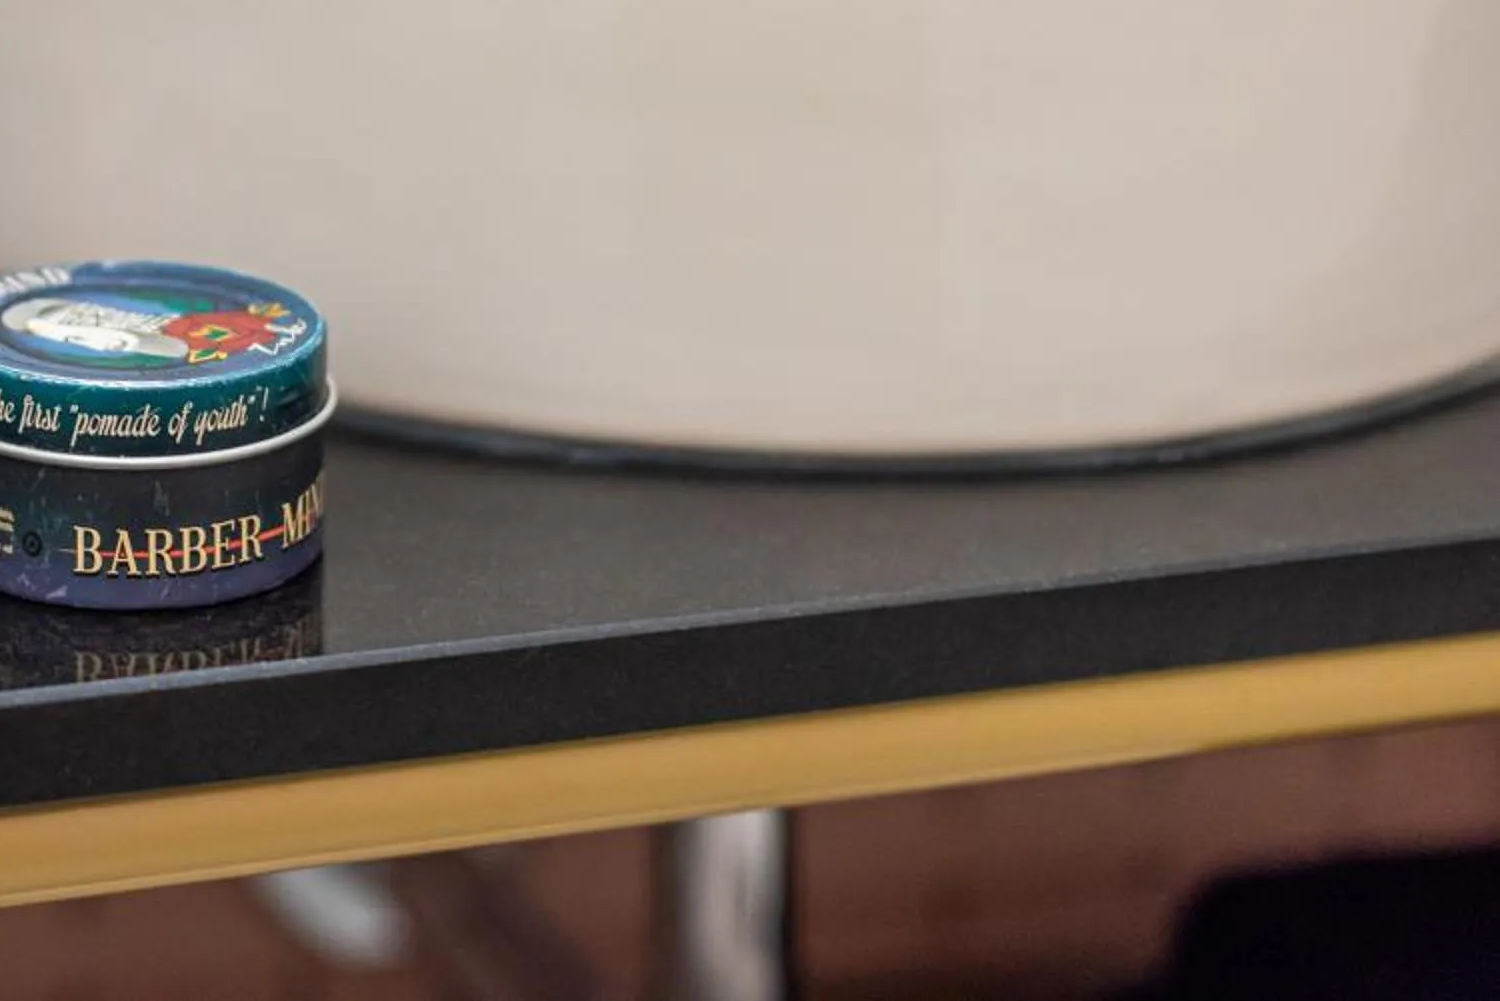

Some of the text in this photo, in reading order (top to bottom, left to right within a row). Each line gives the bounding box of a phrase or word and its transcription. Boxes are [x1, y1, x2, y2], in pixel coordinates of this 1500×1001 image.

[17, 394, 62, 434] first
[168, 400, 194, 444] of
[73, 514, 264, 576] BARBER
